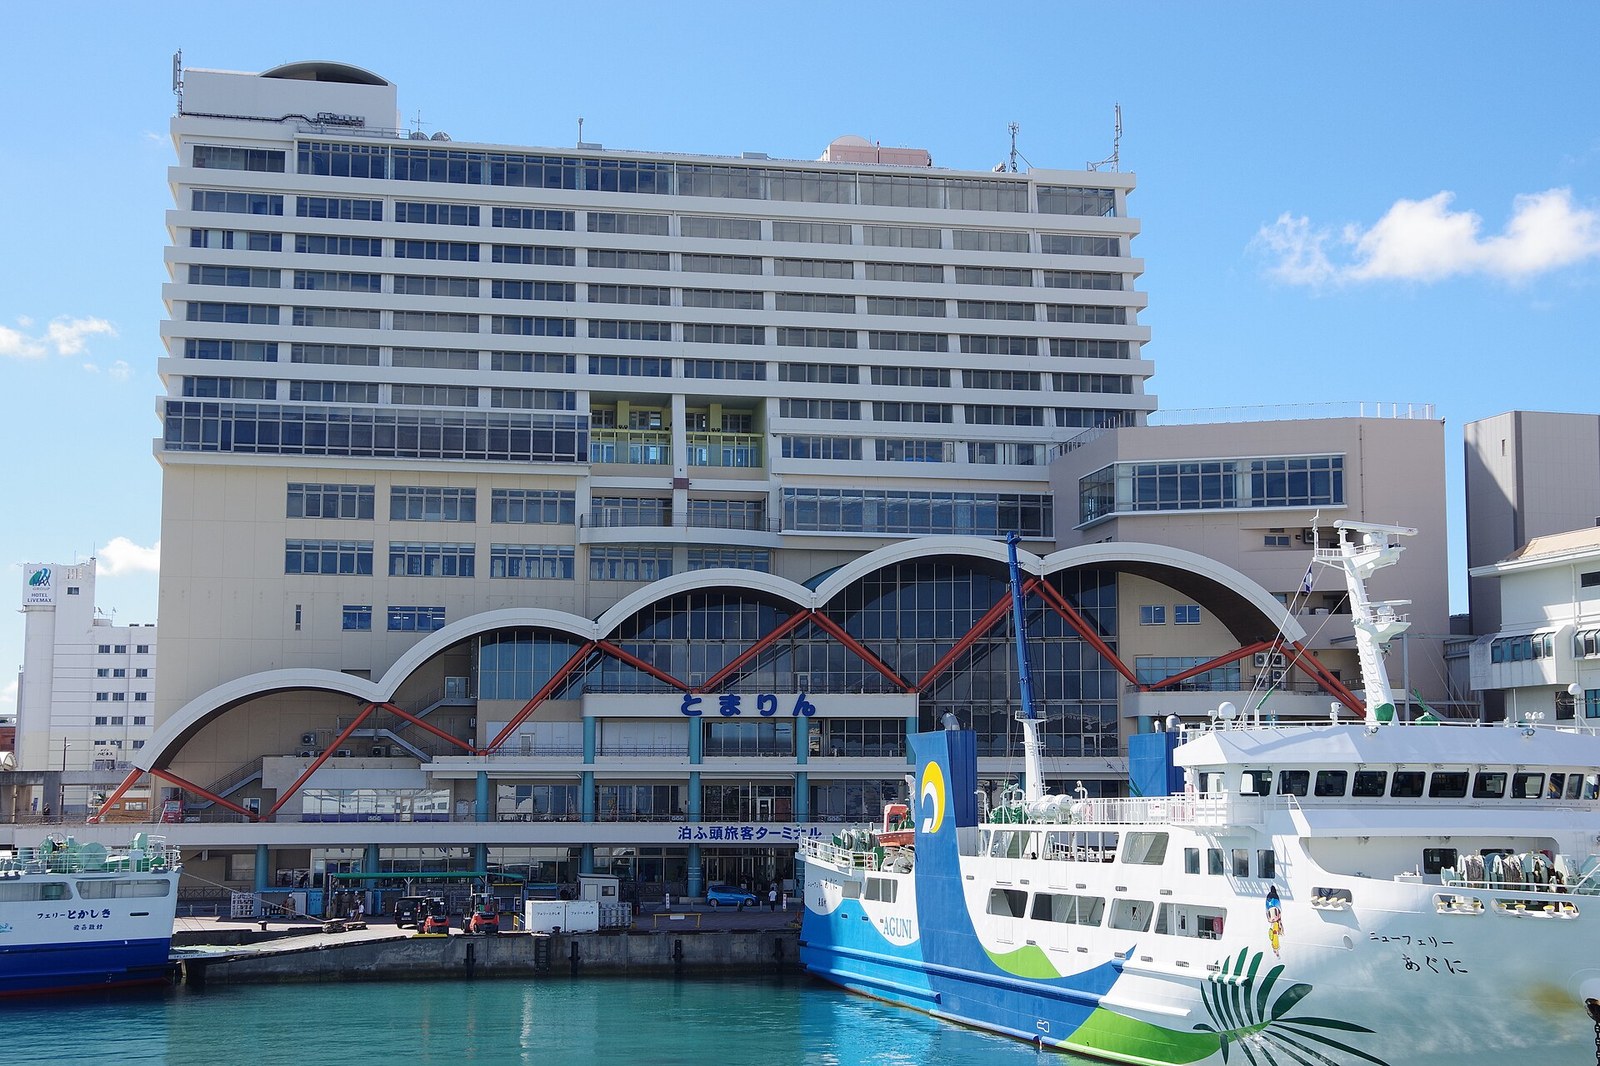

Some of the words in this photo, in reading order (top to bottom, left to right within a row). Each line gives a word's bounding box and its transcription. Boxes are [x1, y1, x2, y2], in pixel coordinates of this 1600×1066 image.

[681, 693, 816, 717] とまりん
[678, 826, 822, 841] 泊ふ頭旅客ターミナル
[37, 908, 111, 920] フェリーとかしき
[883, 916, 913, 939] AGUNI
[1370, 932, 1454, 948] ニューフェリー
[1402, 953, 1468, 975] あぐに
